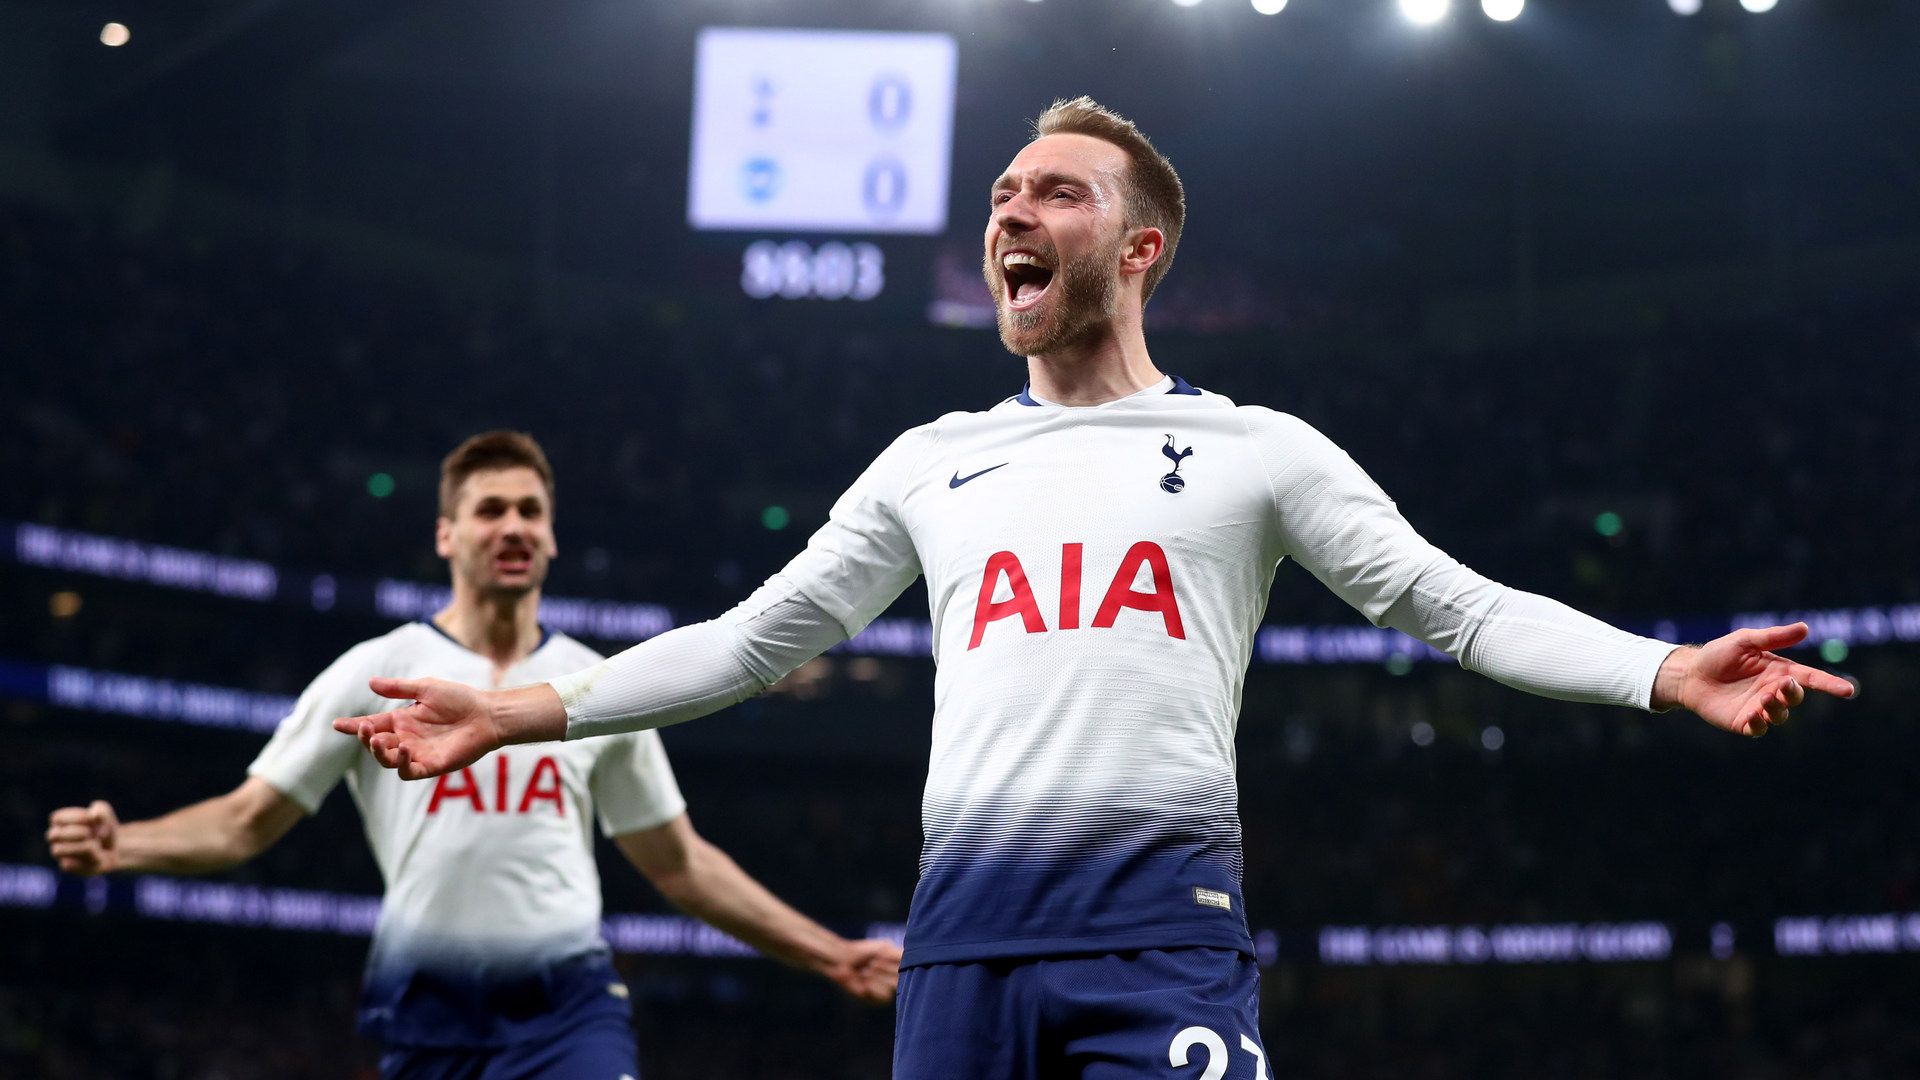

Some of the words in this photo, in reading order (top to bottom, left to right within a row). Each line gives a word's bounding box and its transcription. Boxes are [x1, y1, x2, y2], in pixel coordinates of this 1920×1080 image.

[867, 72, 912, 133] 0
[862, 156, 907, 219] 0
[967, 541, 1186, 651] AIA
[427, 754, 565, 818] AIA
